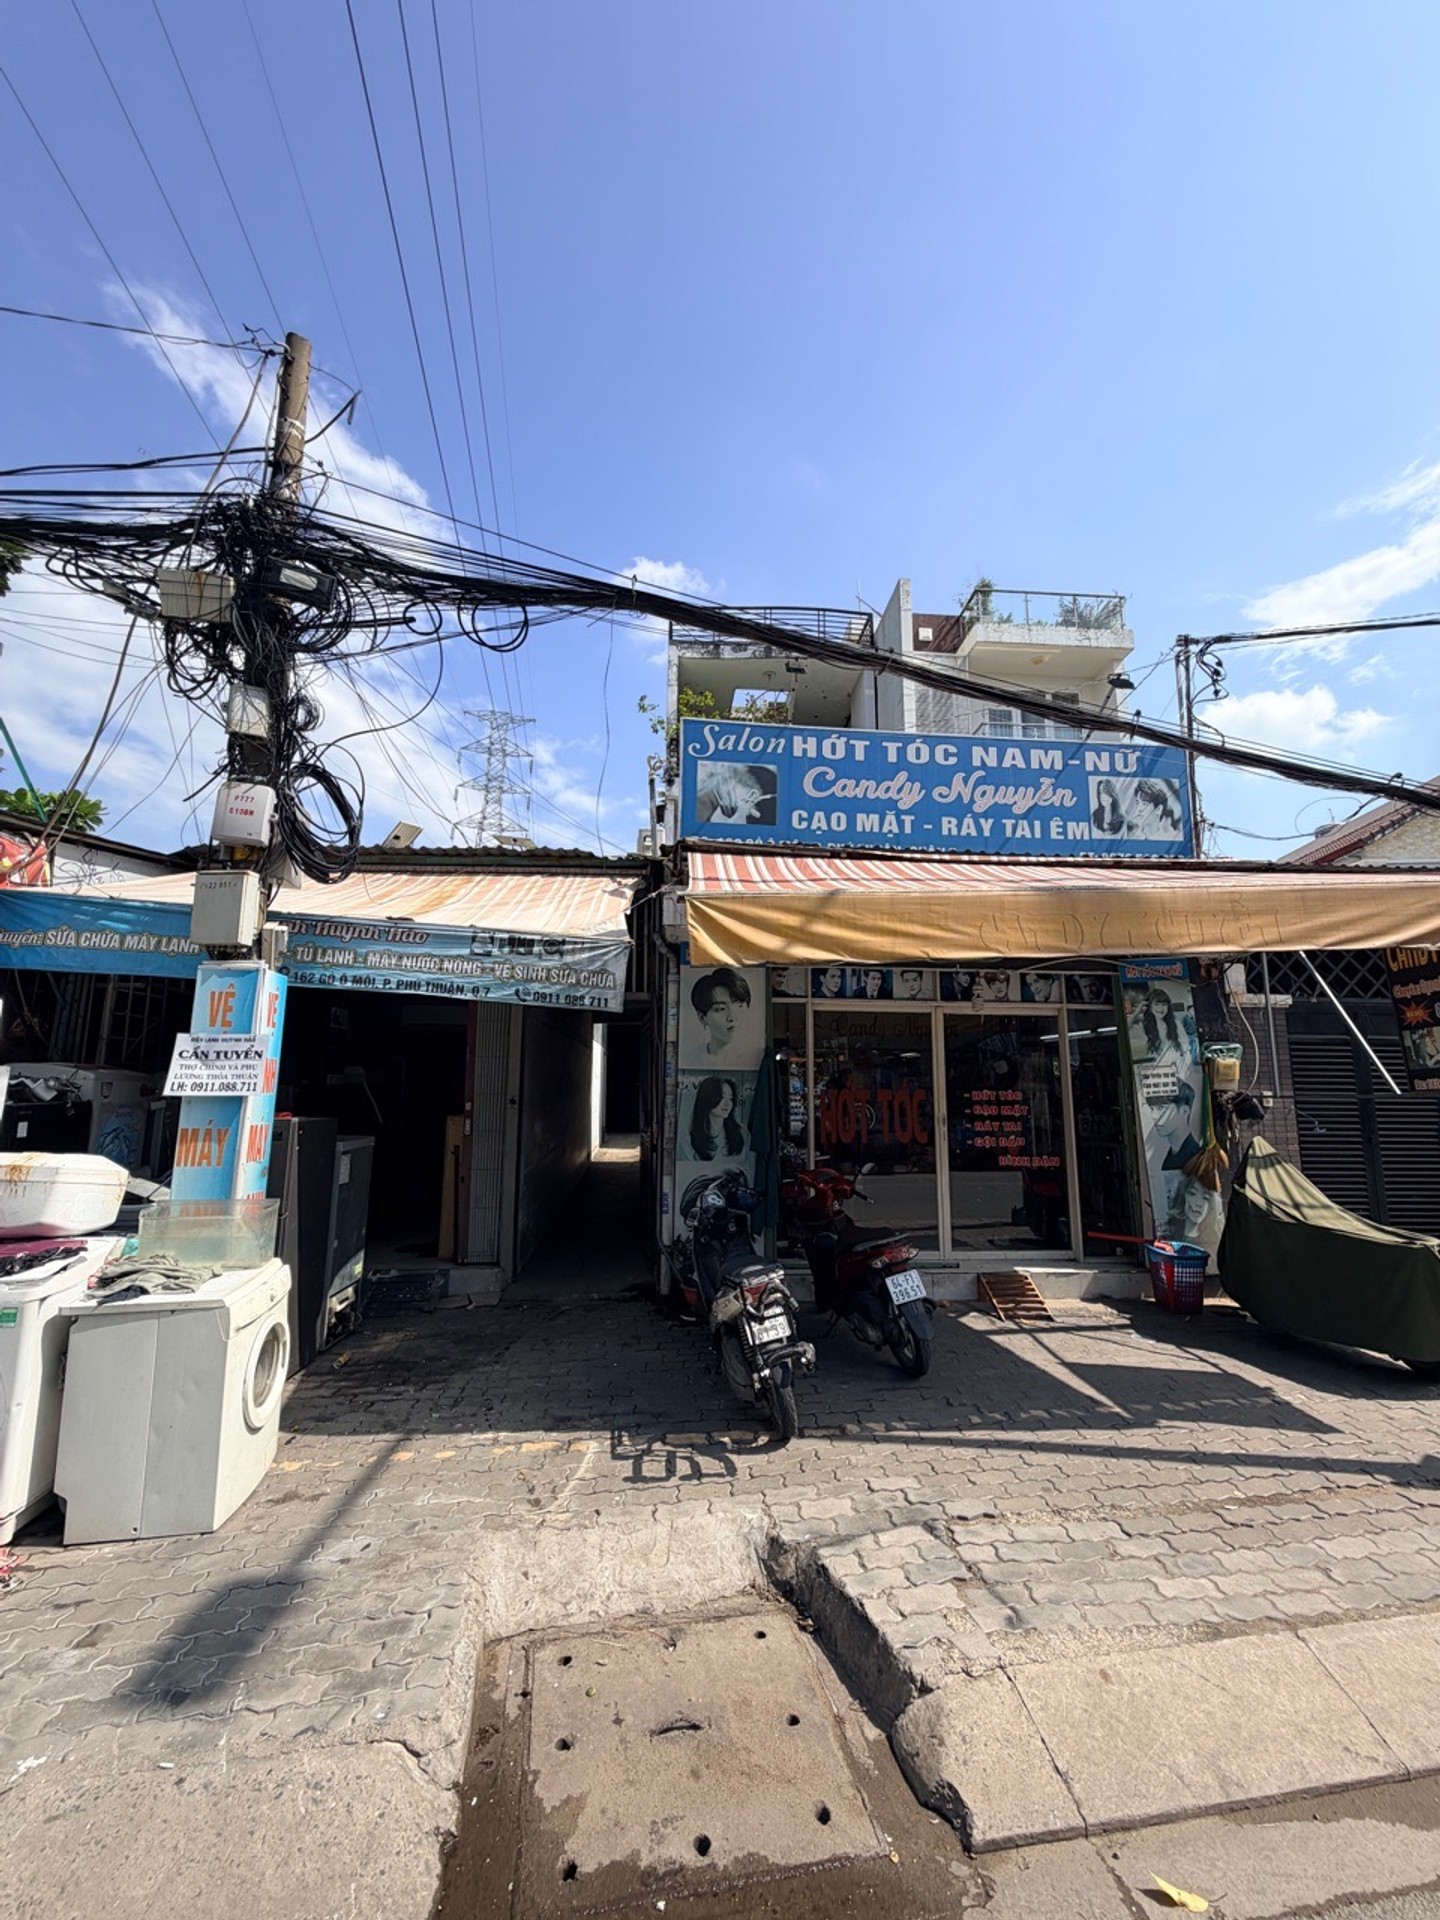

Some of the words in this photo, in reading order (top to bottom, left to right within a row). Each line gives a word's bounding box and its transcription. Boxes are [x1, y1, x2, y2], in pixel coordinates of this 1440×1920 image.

[688, 724, 787, 757] Salon
[793, 734, 870, 762] HỚT
[882, 738, 958, 766] TÓC
[972, 745, 1142, 774] NAM-NỮ
[803, 766, 925, 810] Candy
[932, 770, 1078, 815] Nguyễn
[791, 810, 848, 834] CẠO
[856, 810, 915, 838] MẶT
[941, 814, 994, 837] RÁY
[1002, 819, 1042, 839] TAI
[1050, 818, 1091, 841] ÊM
[46, 926, 76, 946] SỬA
[124, 932, 156, 950] MÁY
[293, 971, 316, 984] 162
[316, 949, 355, 967] LẠNH
[514, 966, 547, 981] SINH
[532, 991, 561, 1004] 0911
[589, 996, 609, 1008] 711
[213, 1044, 264, 1060] TUYỂN
[169, 1081, 188, 1092] LH:
[190, 1081, 258, 1092] 0911.088.711
[176, 1119, 230, 1168] MÁY
[247, 1116, 270, 1163] MÁY
